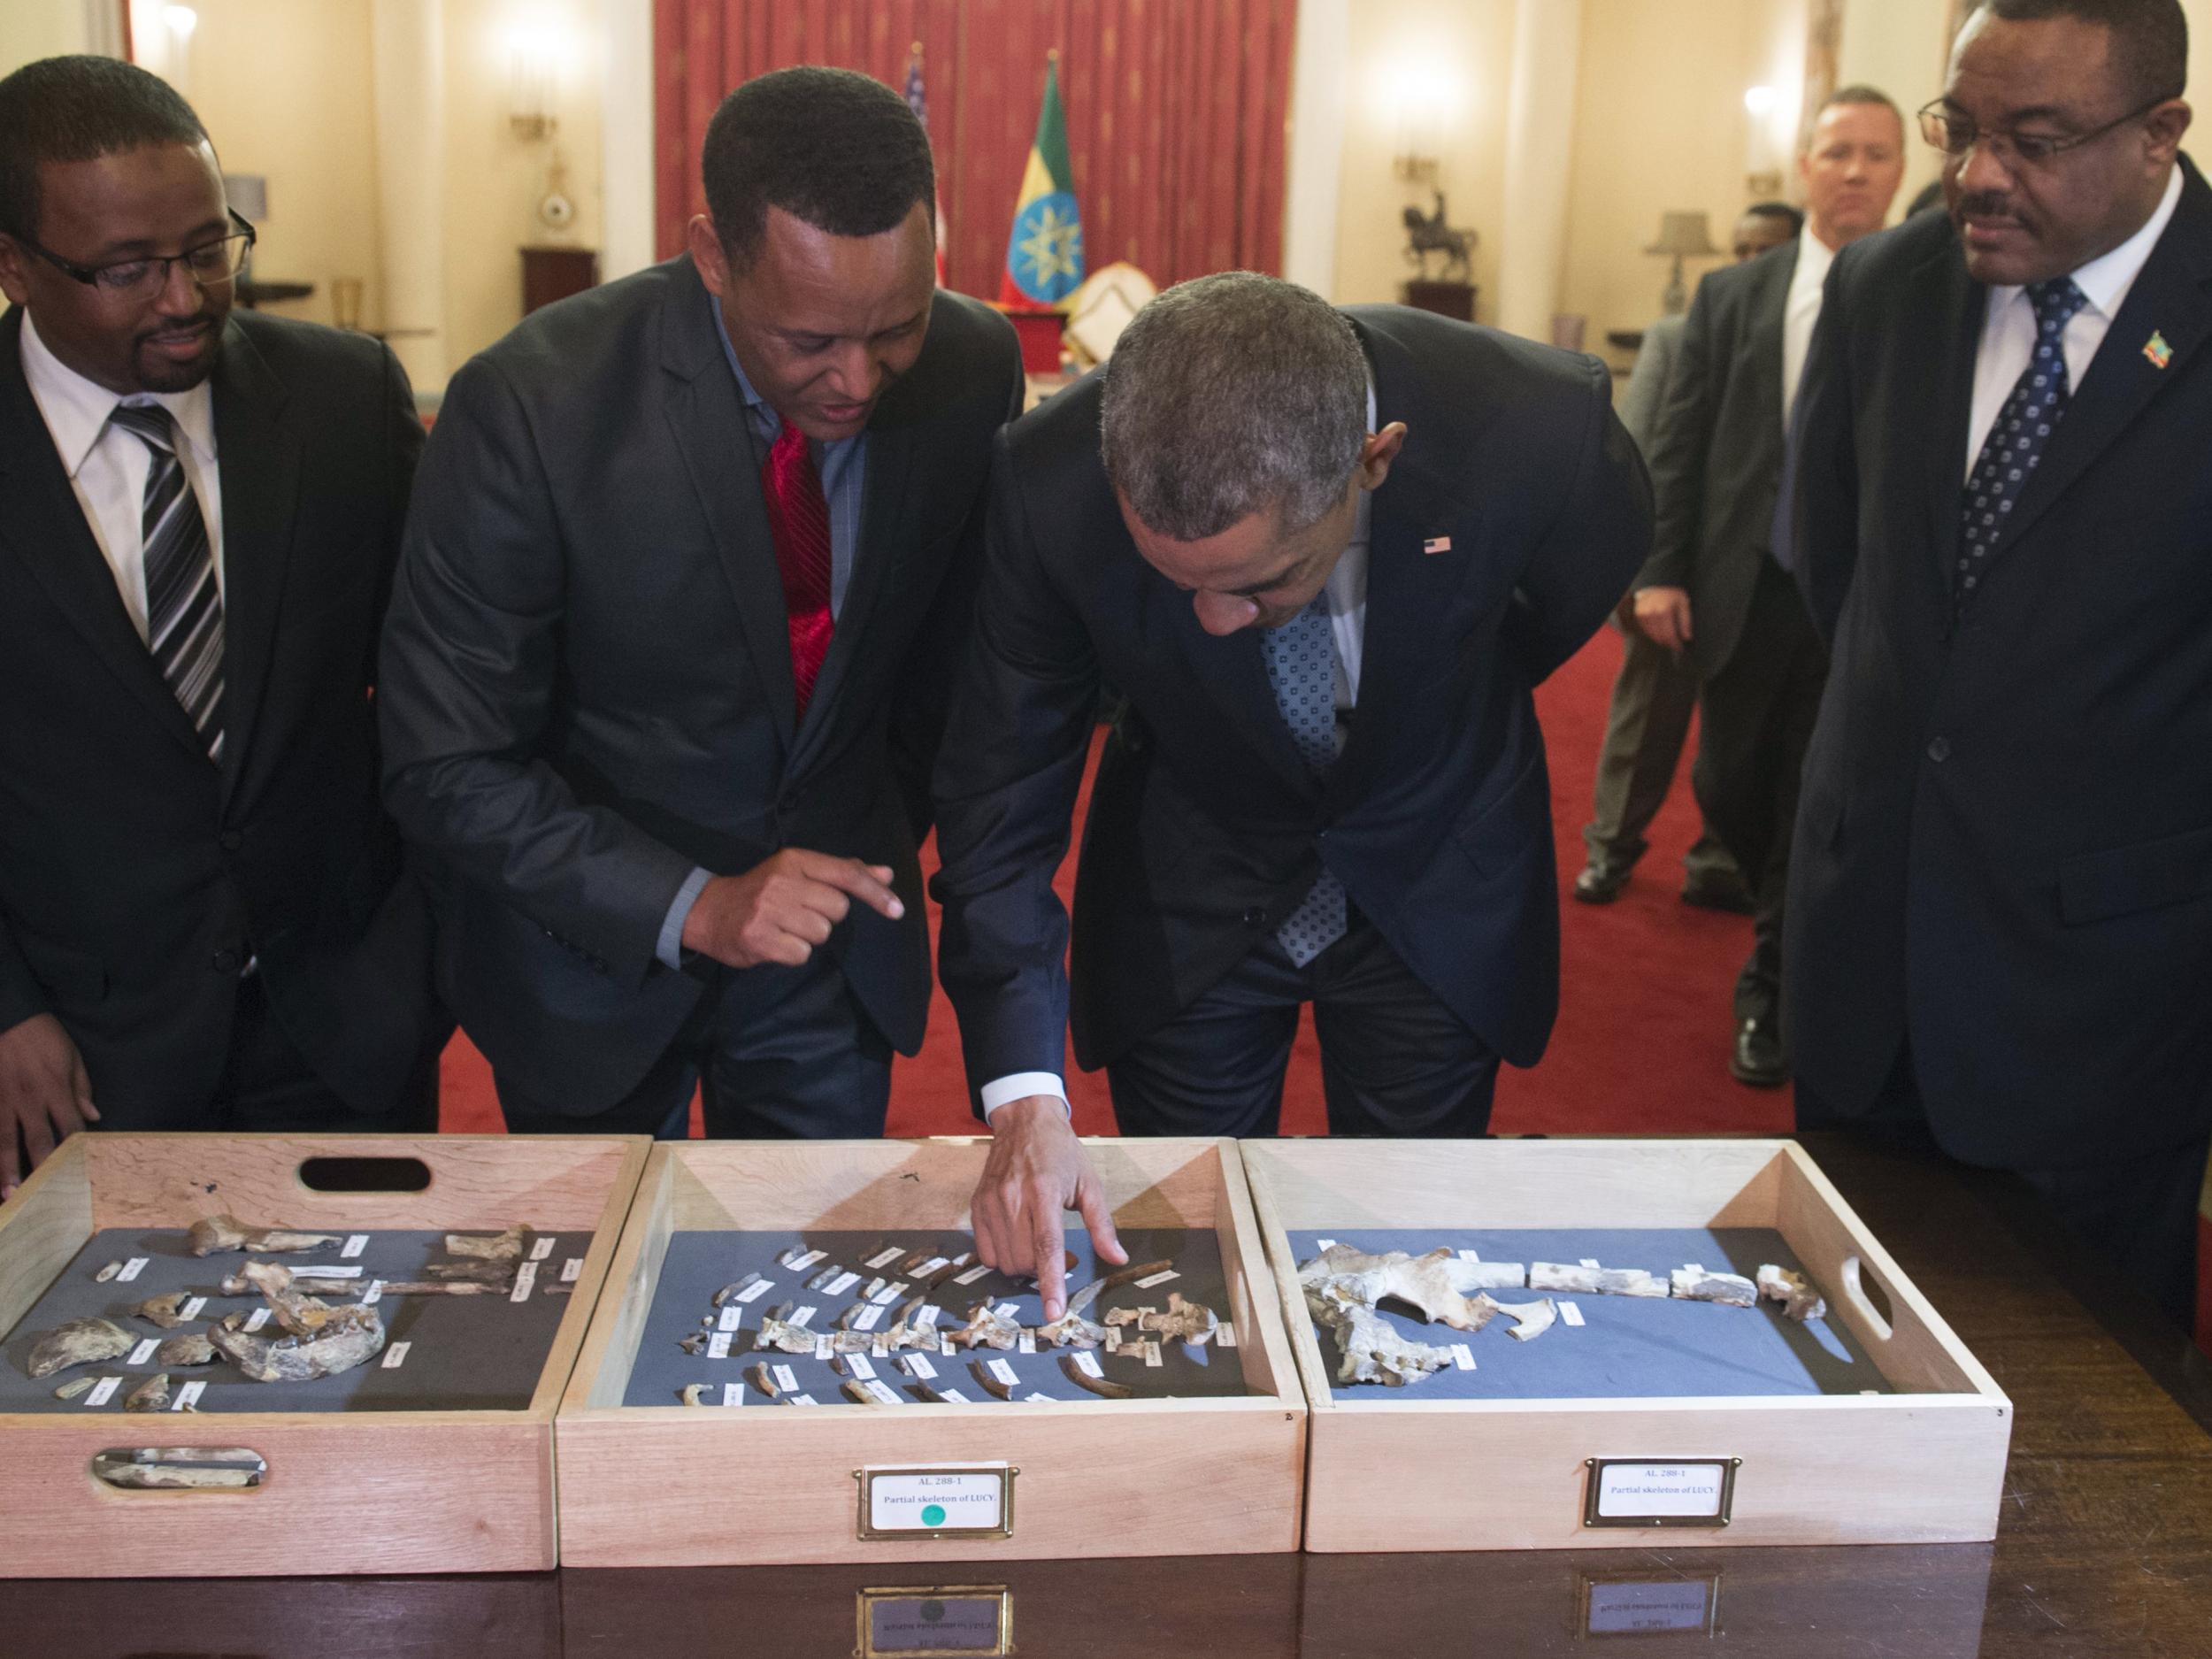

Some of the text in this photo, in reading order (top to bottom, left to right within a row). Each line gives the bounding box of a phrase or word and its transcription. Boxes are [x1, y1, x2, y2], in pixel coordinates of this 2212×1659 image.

[934, 1477, 962, 1486] 288-1
[1610, 1486, 1640, 1494] Partial
[1642, 1486, 1680, 1494] skeleton
[1682, 1486, 1692, 1494] of
[884, 1495, 916, 1504] Partial
[918, 1494, 957, 1503] skeleton
[959, 1494, 969, 1502] of
